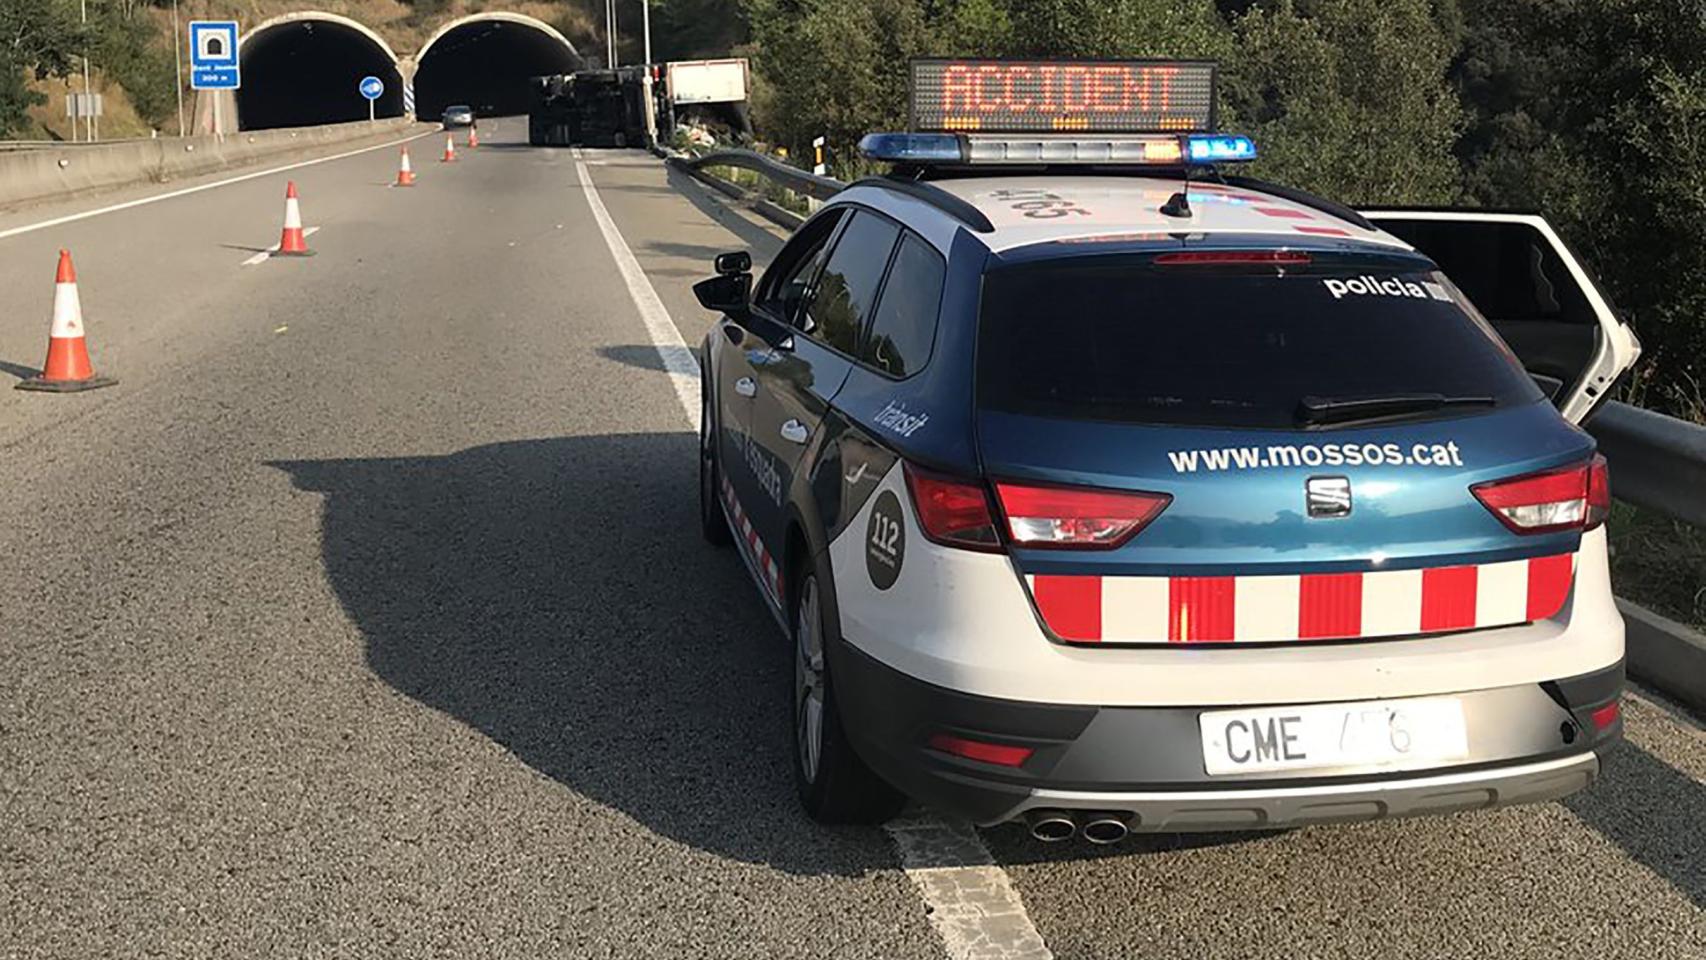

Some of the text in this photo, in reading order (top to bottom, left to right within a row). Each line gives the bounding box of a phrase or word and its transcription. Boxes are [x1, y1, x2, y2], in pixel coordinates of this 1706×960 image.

[944, 65, 1179, 112] ACCIDENT
[1323, 275, 1427, 299] policia
[1168, 441, 1463, 473] www.mossos.cat
[871, 511, 899, 556] 112
[1225, 715, 1307, 764] CME
